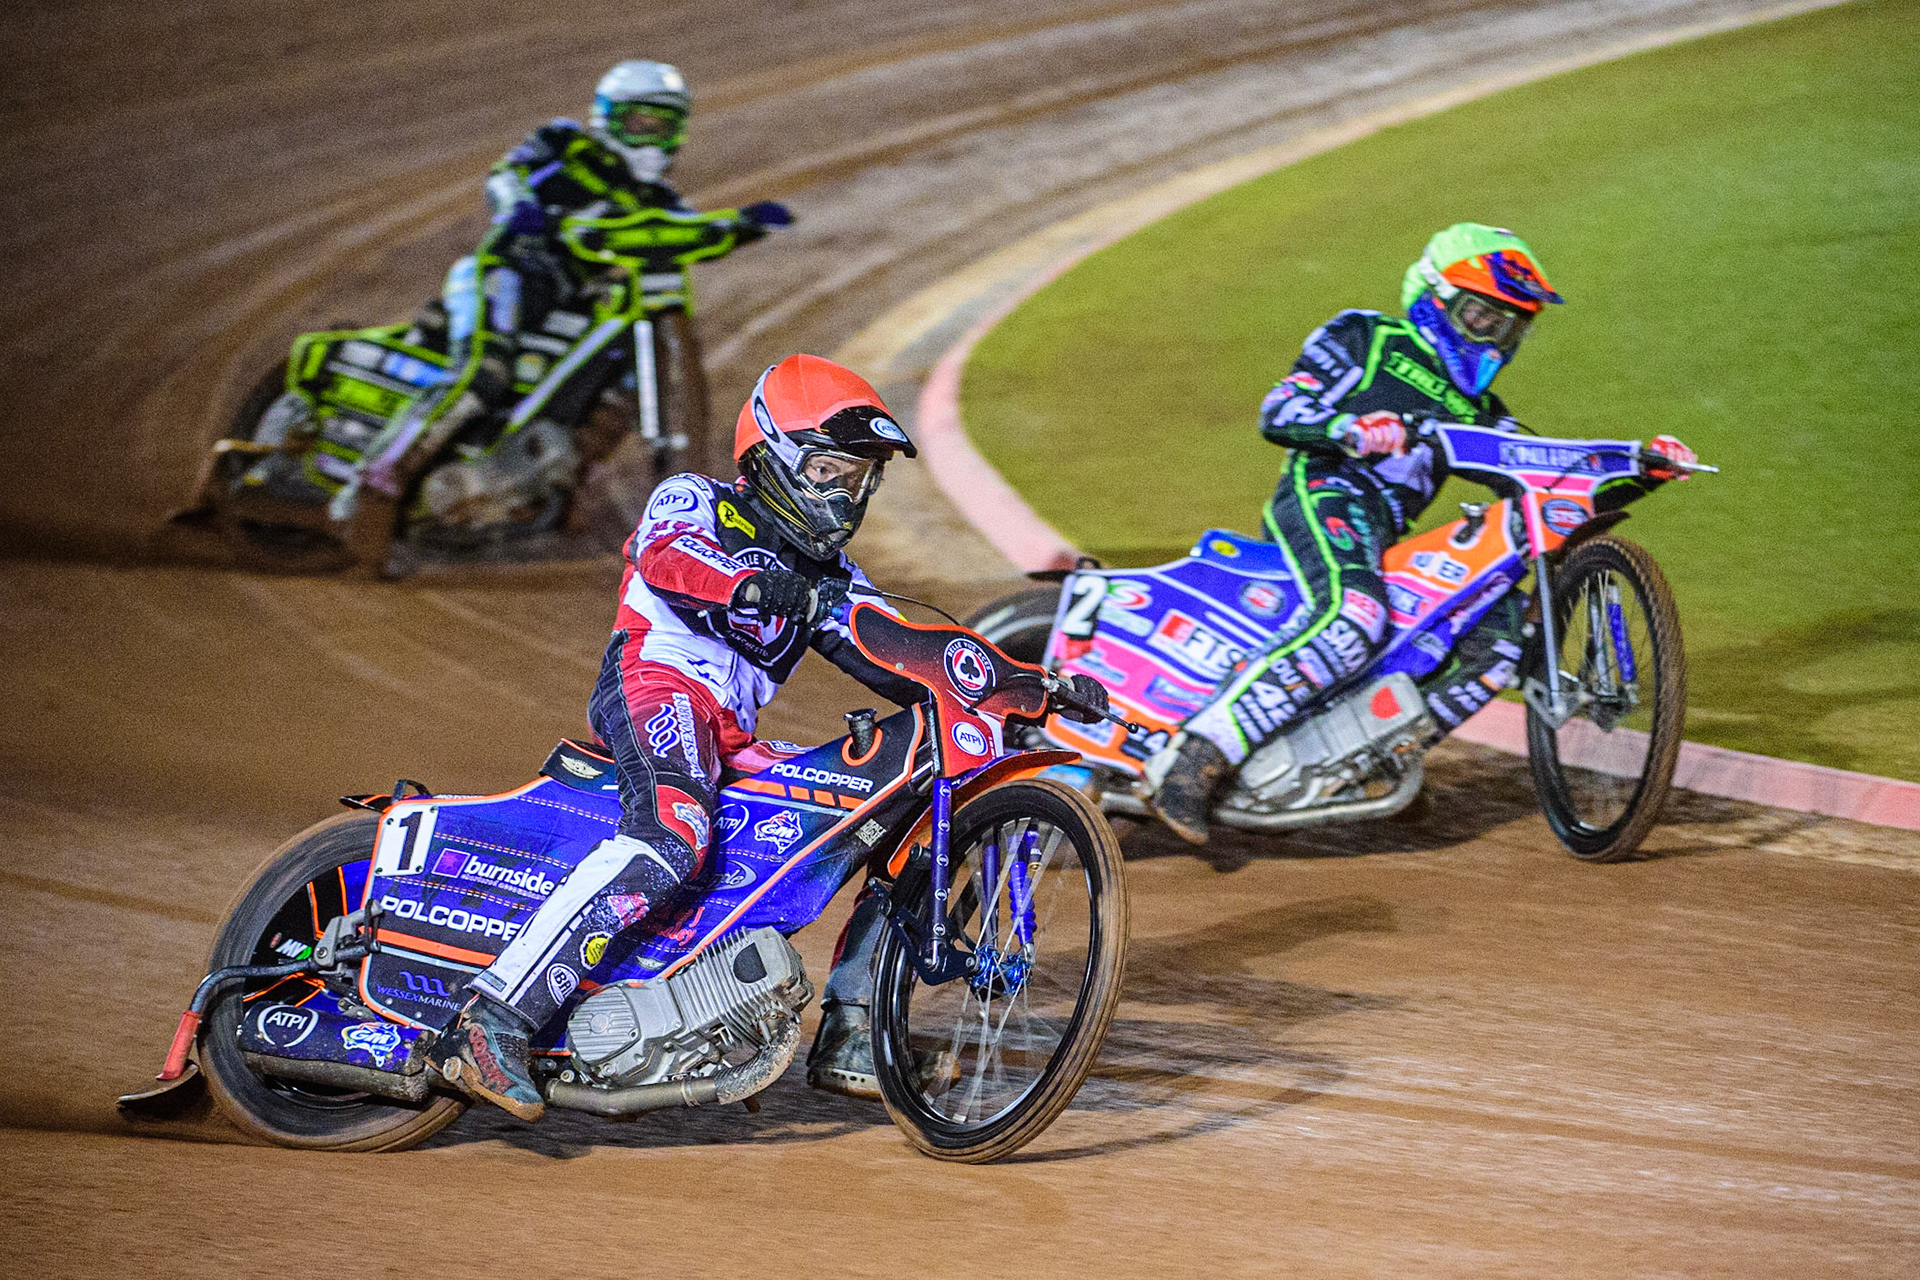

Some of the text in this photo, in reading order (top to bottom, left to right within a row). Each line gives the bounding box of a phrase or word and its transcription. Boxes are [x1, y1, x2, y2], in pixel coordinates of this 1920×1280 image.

[1062, 576, 1107, 635] 2
[672, 692, 705, 779] WESSEXMARINE
[960, 732, 981, 745] ATPI
[771, 763, 874, 793] POLCOPPER
[397, 811, 424, 870] 1
[464, 855, 555, 895] burnside
[379, 894, 522, 942] POLCOPPE
[376, 985, 462, 1012] WESSEXMARINE
[266, 1012, 308, 1030] ATPI
[350, 1029, 389, 1045] GM
